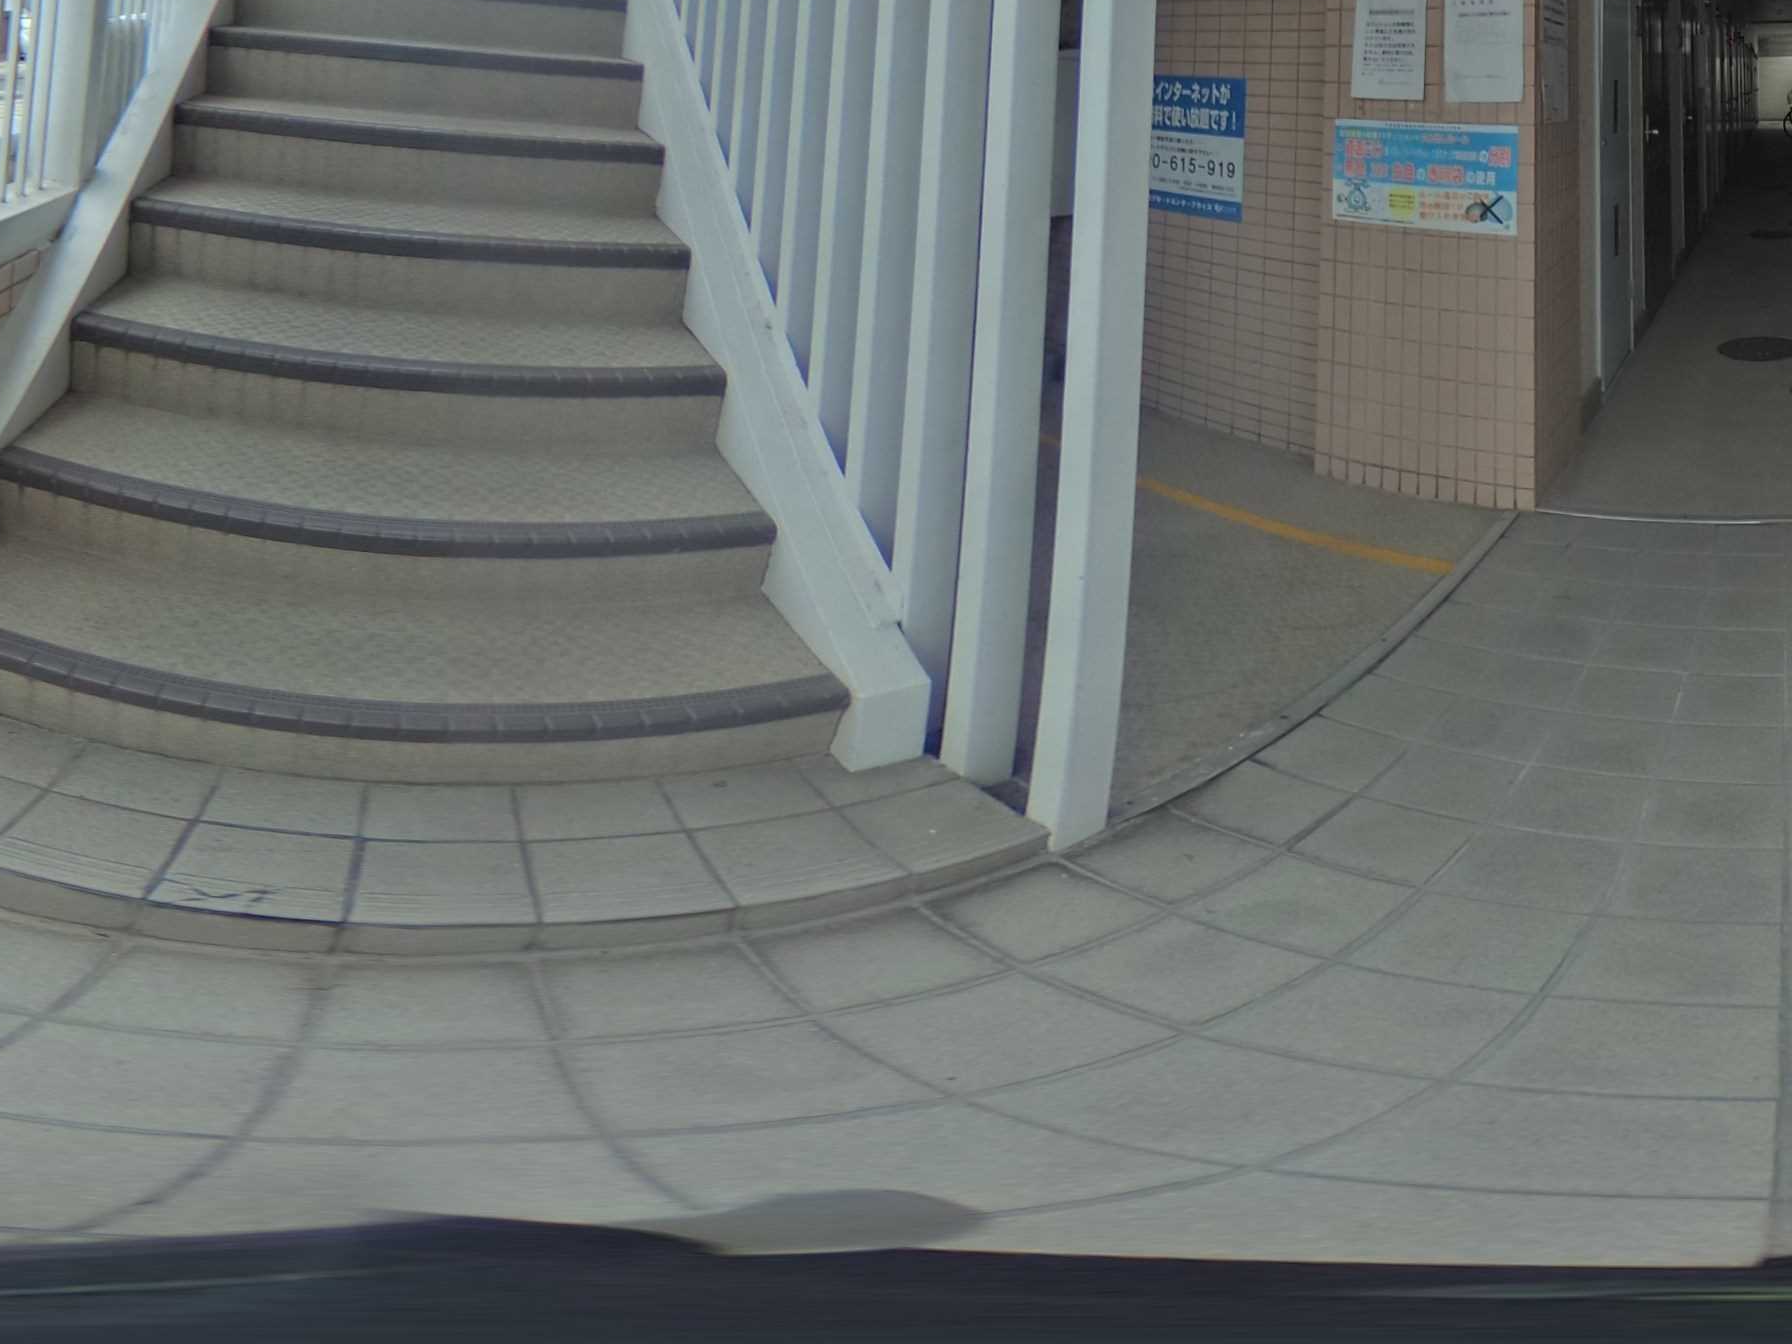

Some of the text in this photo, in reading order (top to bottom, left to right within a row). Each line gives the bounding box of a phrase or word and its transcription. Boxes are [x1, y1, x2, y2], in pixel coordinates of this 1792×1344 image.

[1155, 81, 1231, 105] インターネットが
